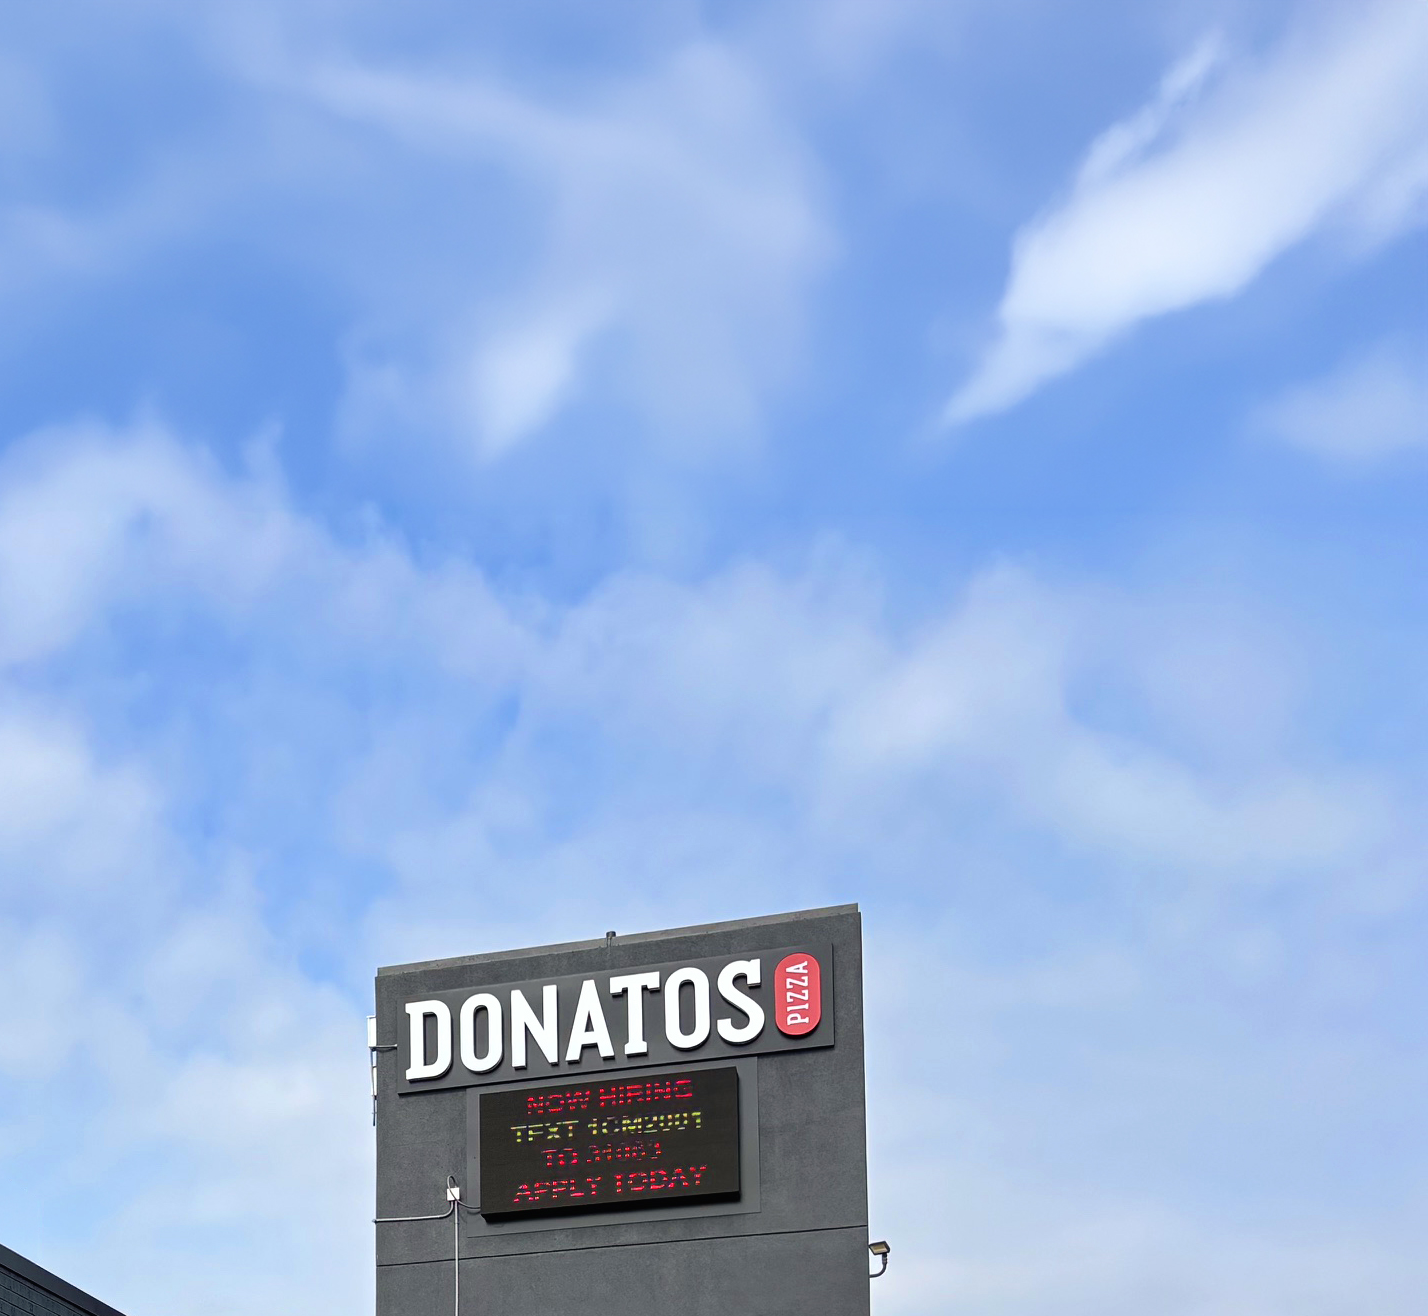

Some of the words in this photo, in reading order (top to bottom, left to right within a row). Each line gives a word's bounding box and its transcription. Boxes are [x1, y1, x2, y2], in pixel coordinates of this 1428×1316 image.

[405, 958, 766, 1081] DONATOS
[786, 960, 810, 1026] PIZZA
[527, 1090, 591, 1115] NOW
[599, 1079, 693, 1107] HIRING
[510, 1119, 579, 1142] TEXT
[513, 1176, 603, 1203] APPLY
[614, 1164, 707, 1193] TODAY
